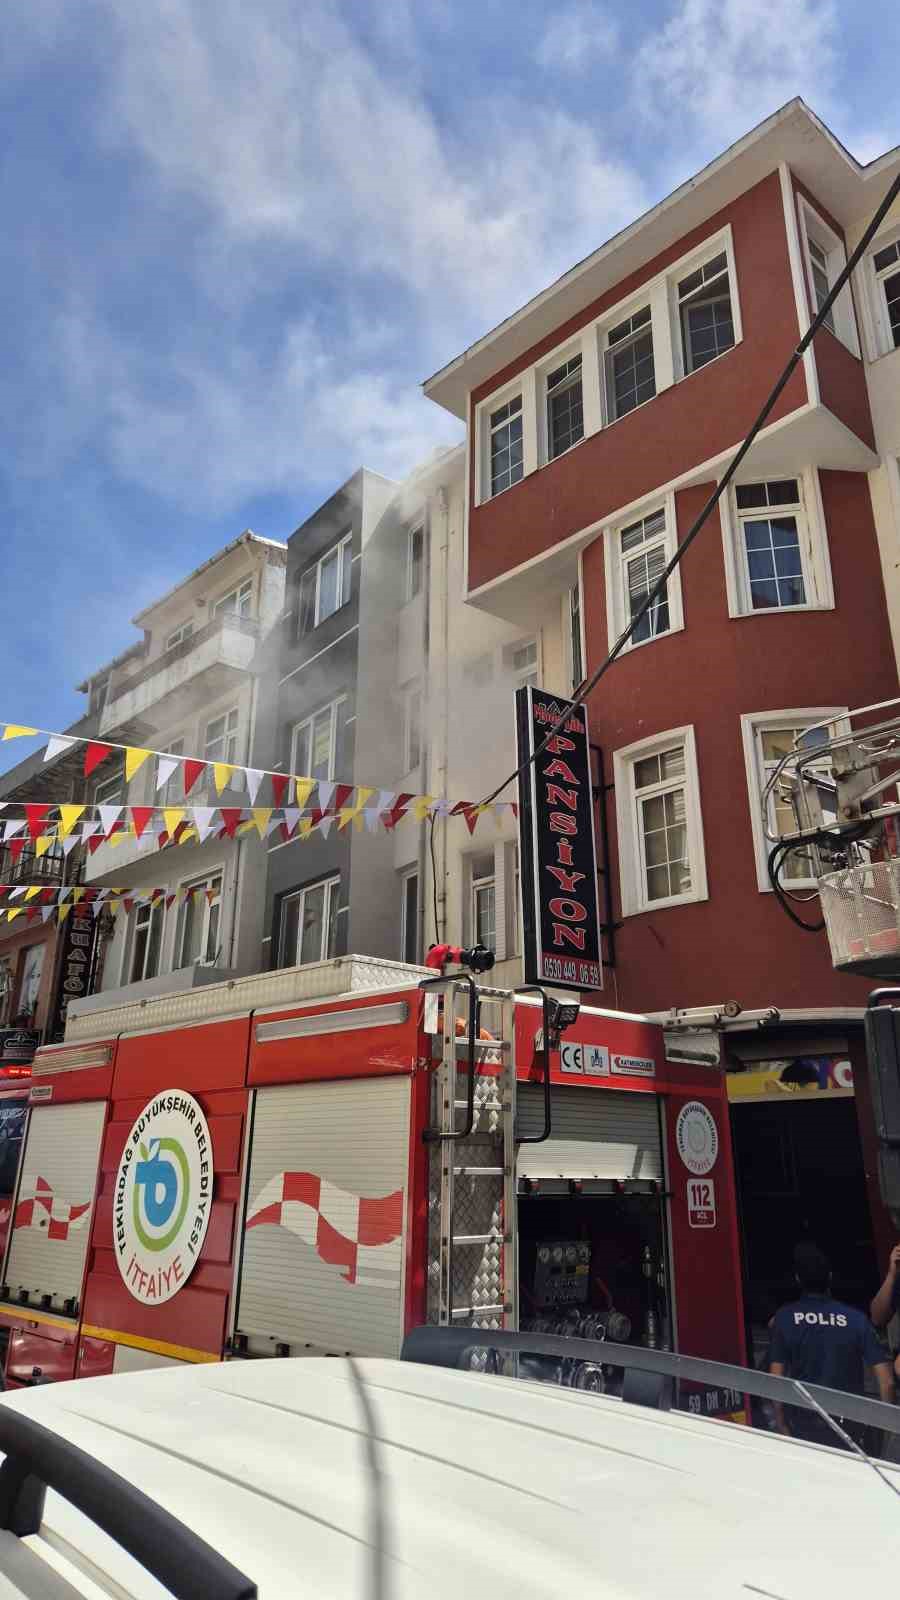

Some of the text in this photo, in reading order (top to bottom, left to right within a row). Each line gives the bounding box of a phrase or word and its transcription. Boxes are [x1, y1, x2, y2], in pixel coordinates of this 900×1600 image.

[543, 732, 587, 950] PANSİYON
[562, 1046, 582, 1069] CE
[116, 1096, 209, 1257] TEKİRDAĞ BÜYÜKŞEHİR BELEDİYESİ
[691, 1184, 711, 1207] 112
[126, 1253, 184, 1299] İTFAİYE
[793, 1311, 848, 1327] POLİS
